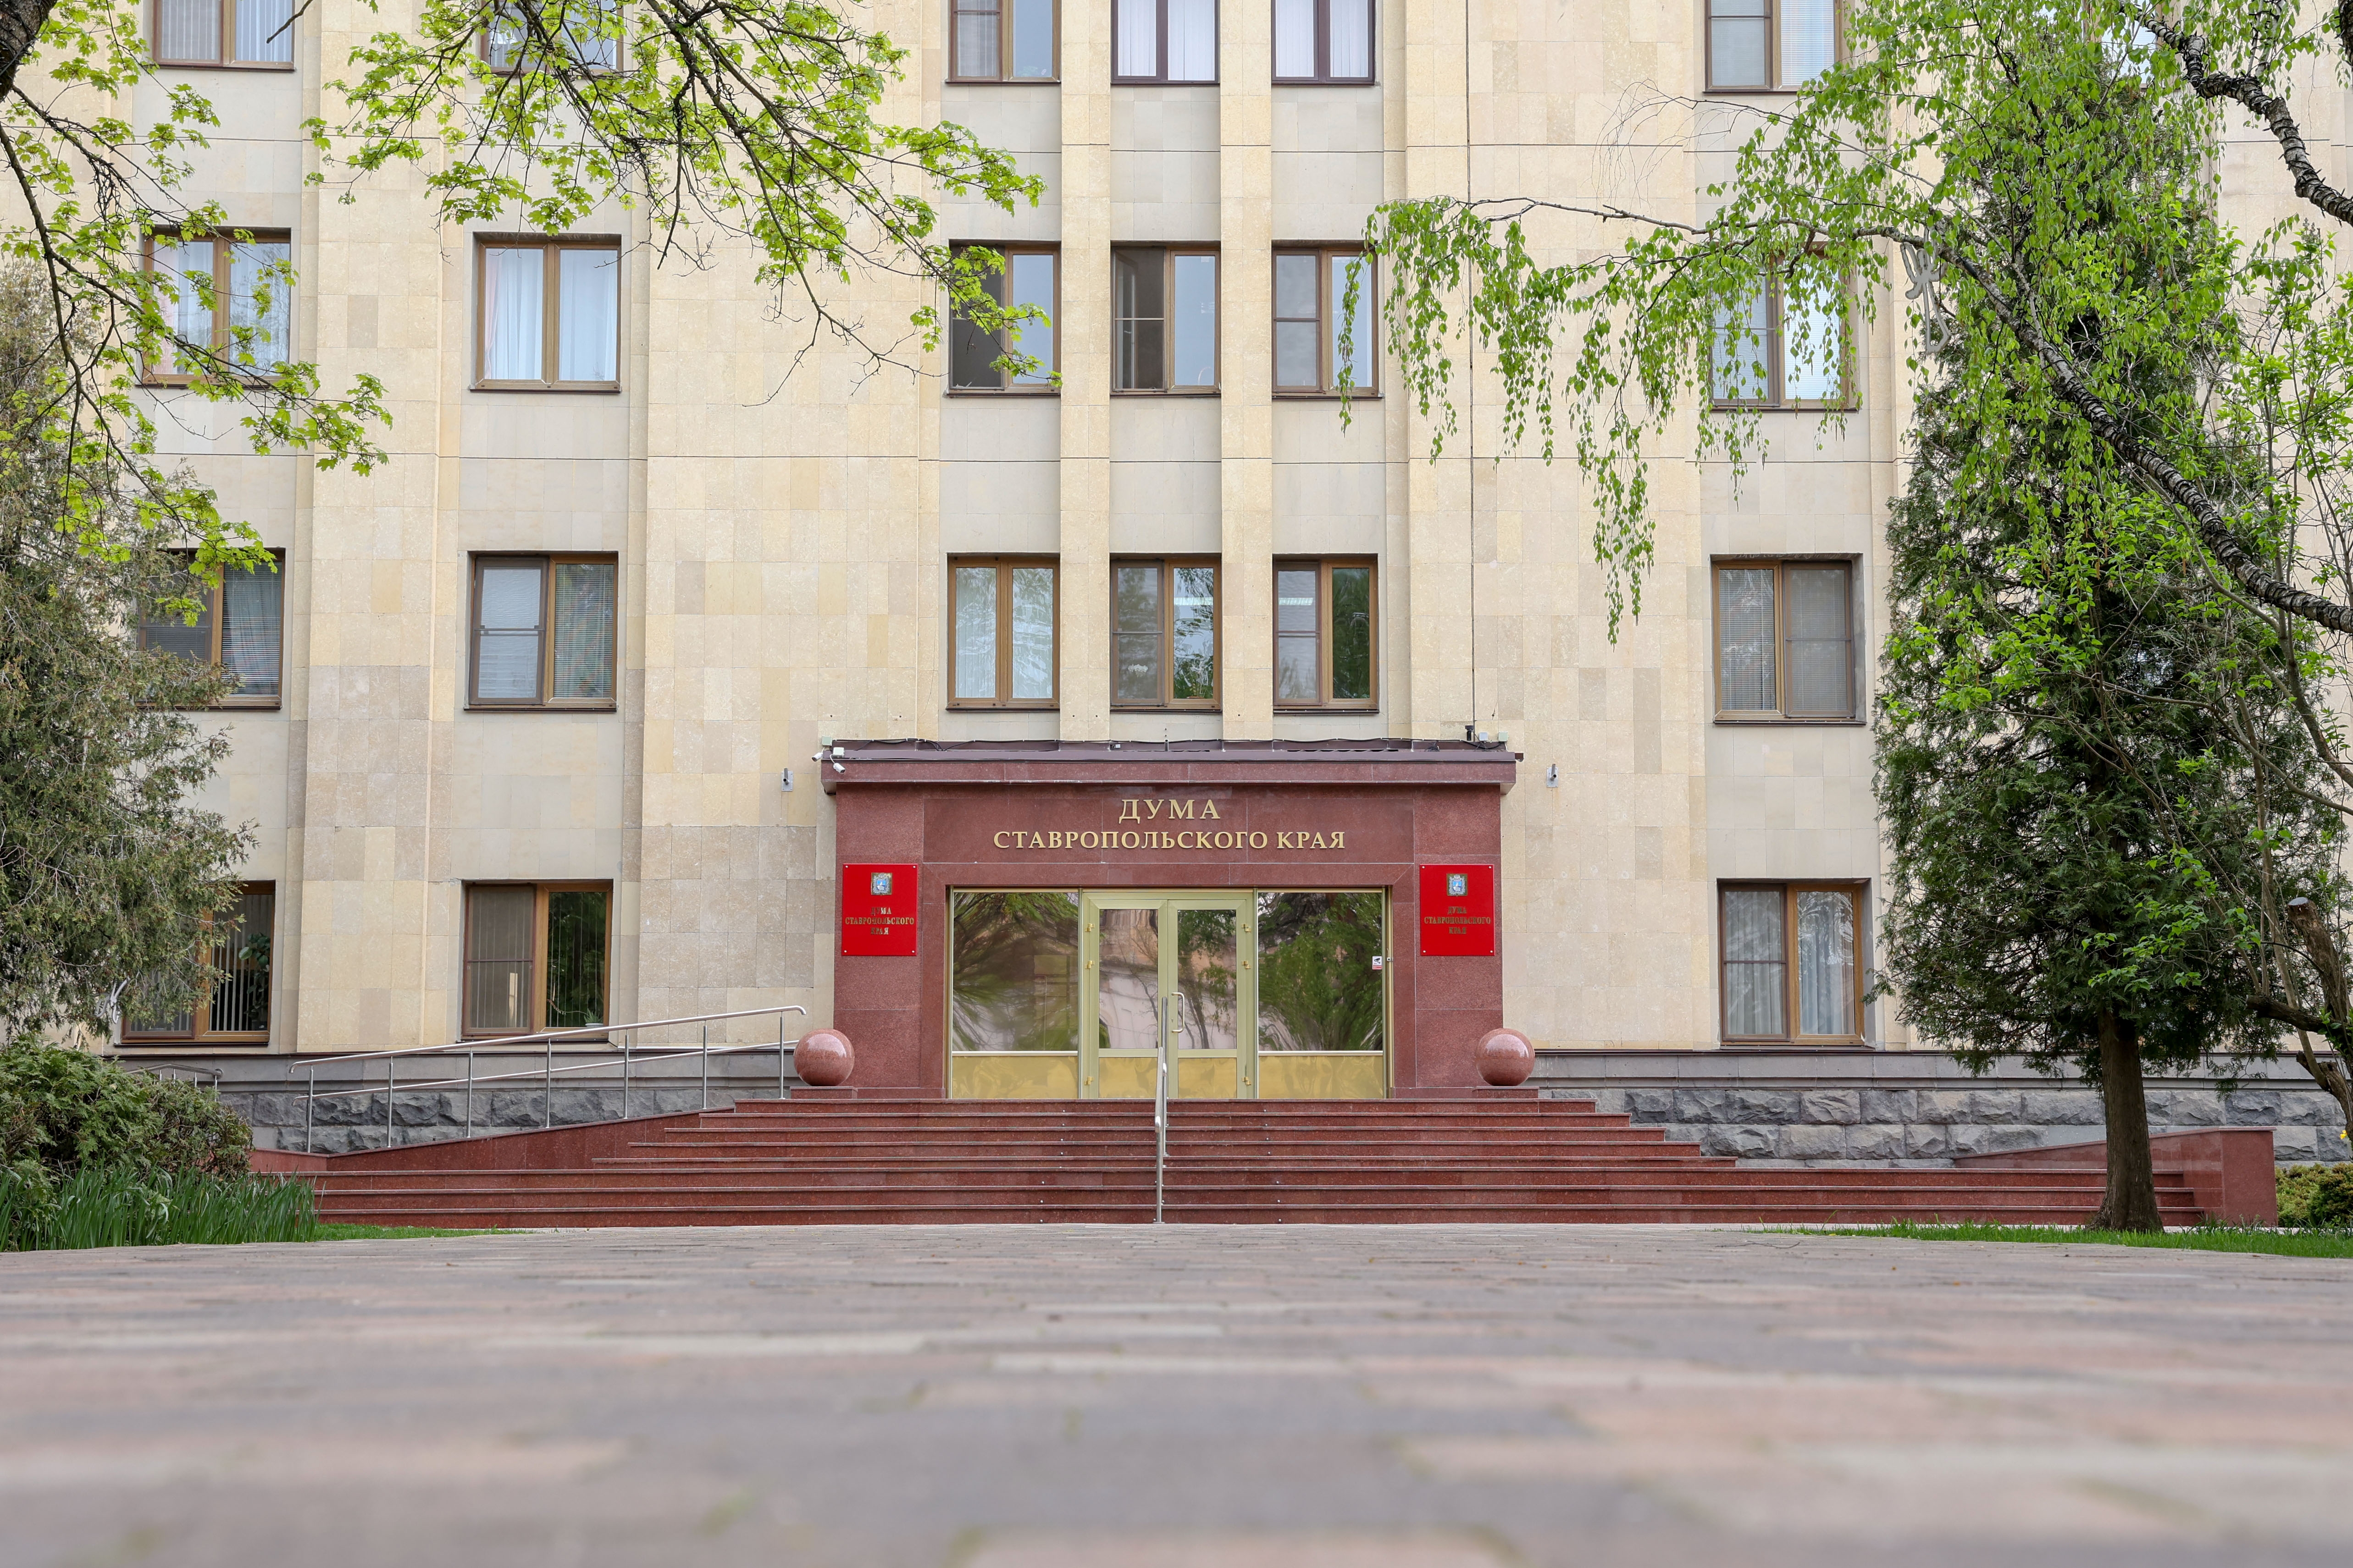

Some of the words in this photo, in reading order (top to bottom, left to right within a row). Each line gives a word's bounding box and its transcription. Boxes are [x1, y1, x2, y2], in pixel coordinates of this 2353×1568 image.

[1119, 799, 1221, 824] ДУМА
[993, 831, 1268, 850] СТАВРОПОЛЬСКОГО
[1277, 831, 1345, 850] КРАЯ
[871, 907, 892, 916] ДУМА
[1448, 906, 1467, 915] ДУМА
